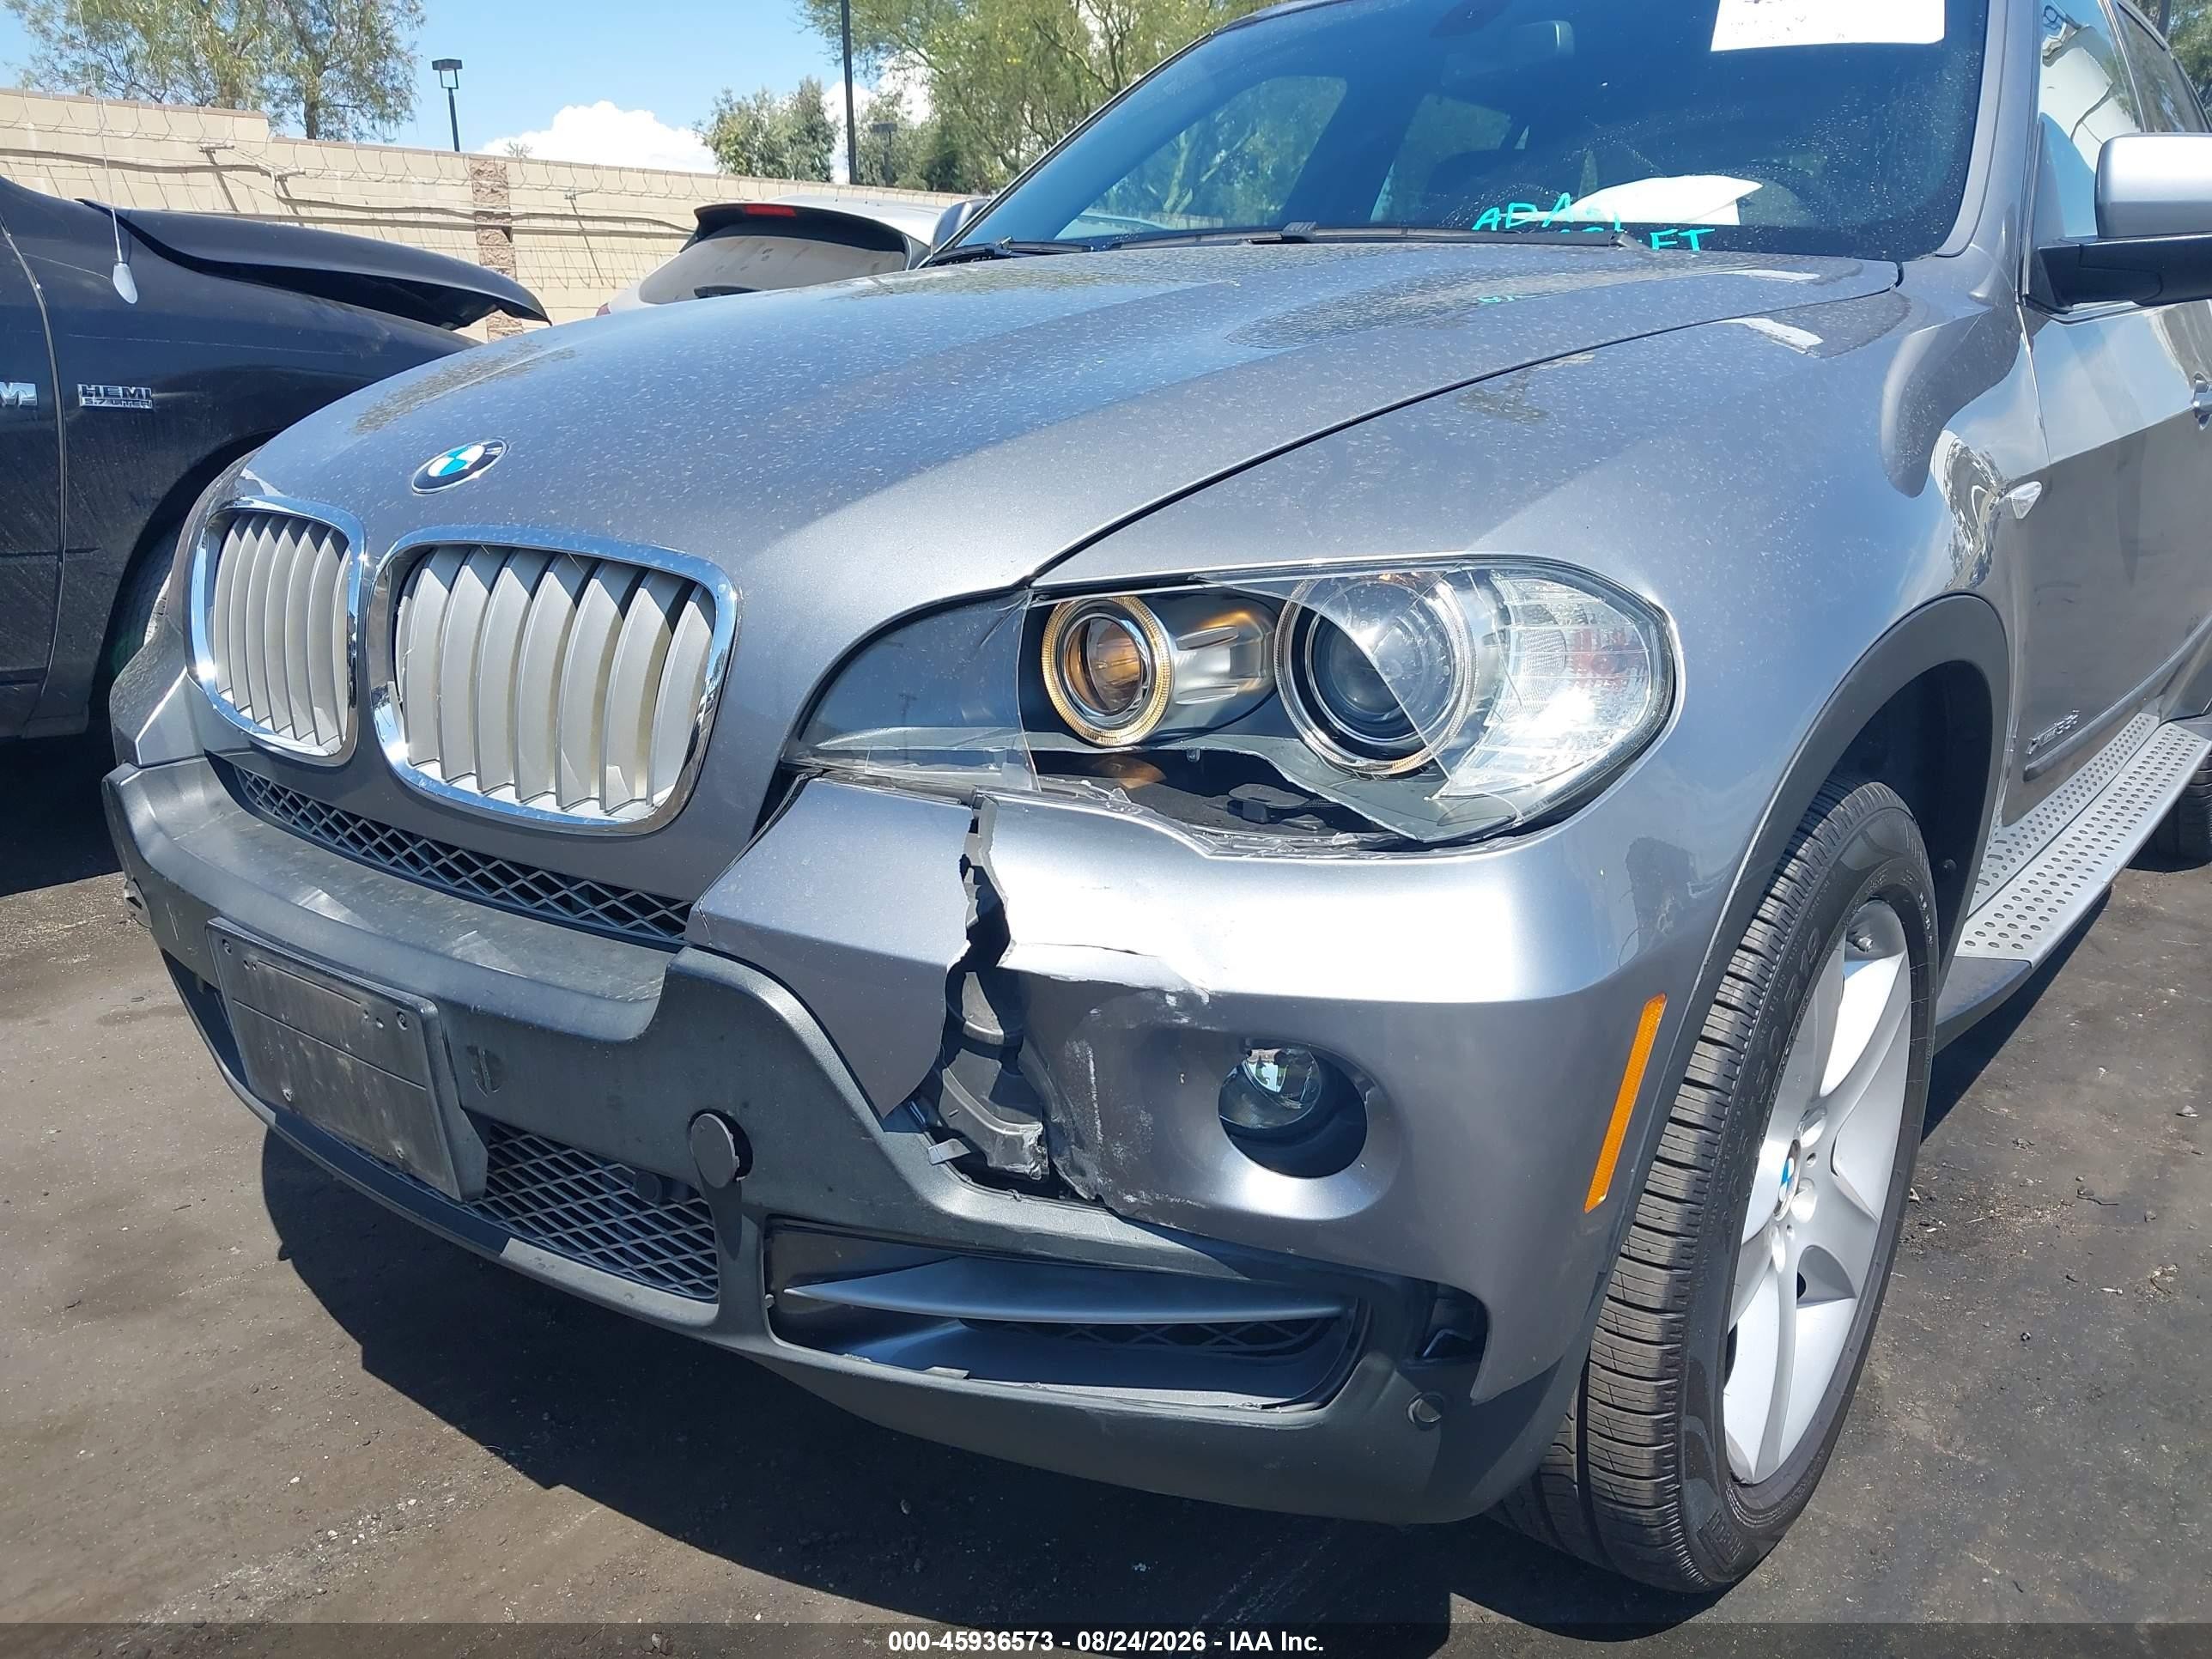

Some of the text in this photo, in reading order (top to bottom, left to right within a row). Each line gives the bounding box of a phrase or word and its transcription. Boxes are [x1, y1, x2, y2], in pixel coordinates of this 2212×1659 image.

[81, 384, 152, 401] HEMI
[84, 398, 152, 408] 5.7 LITER
